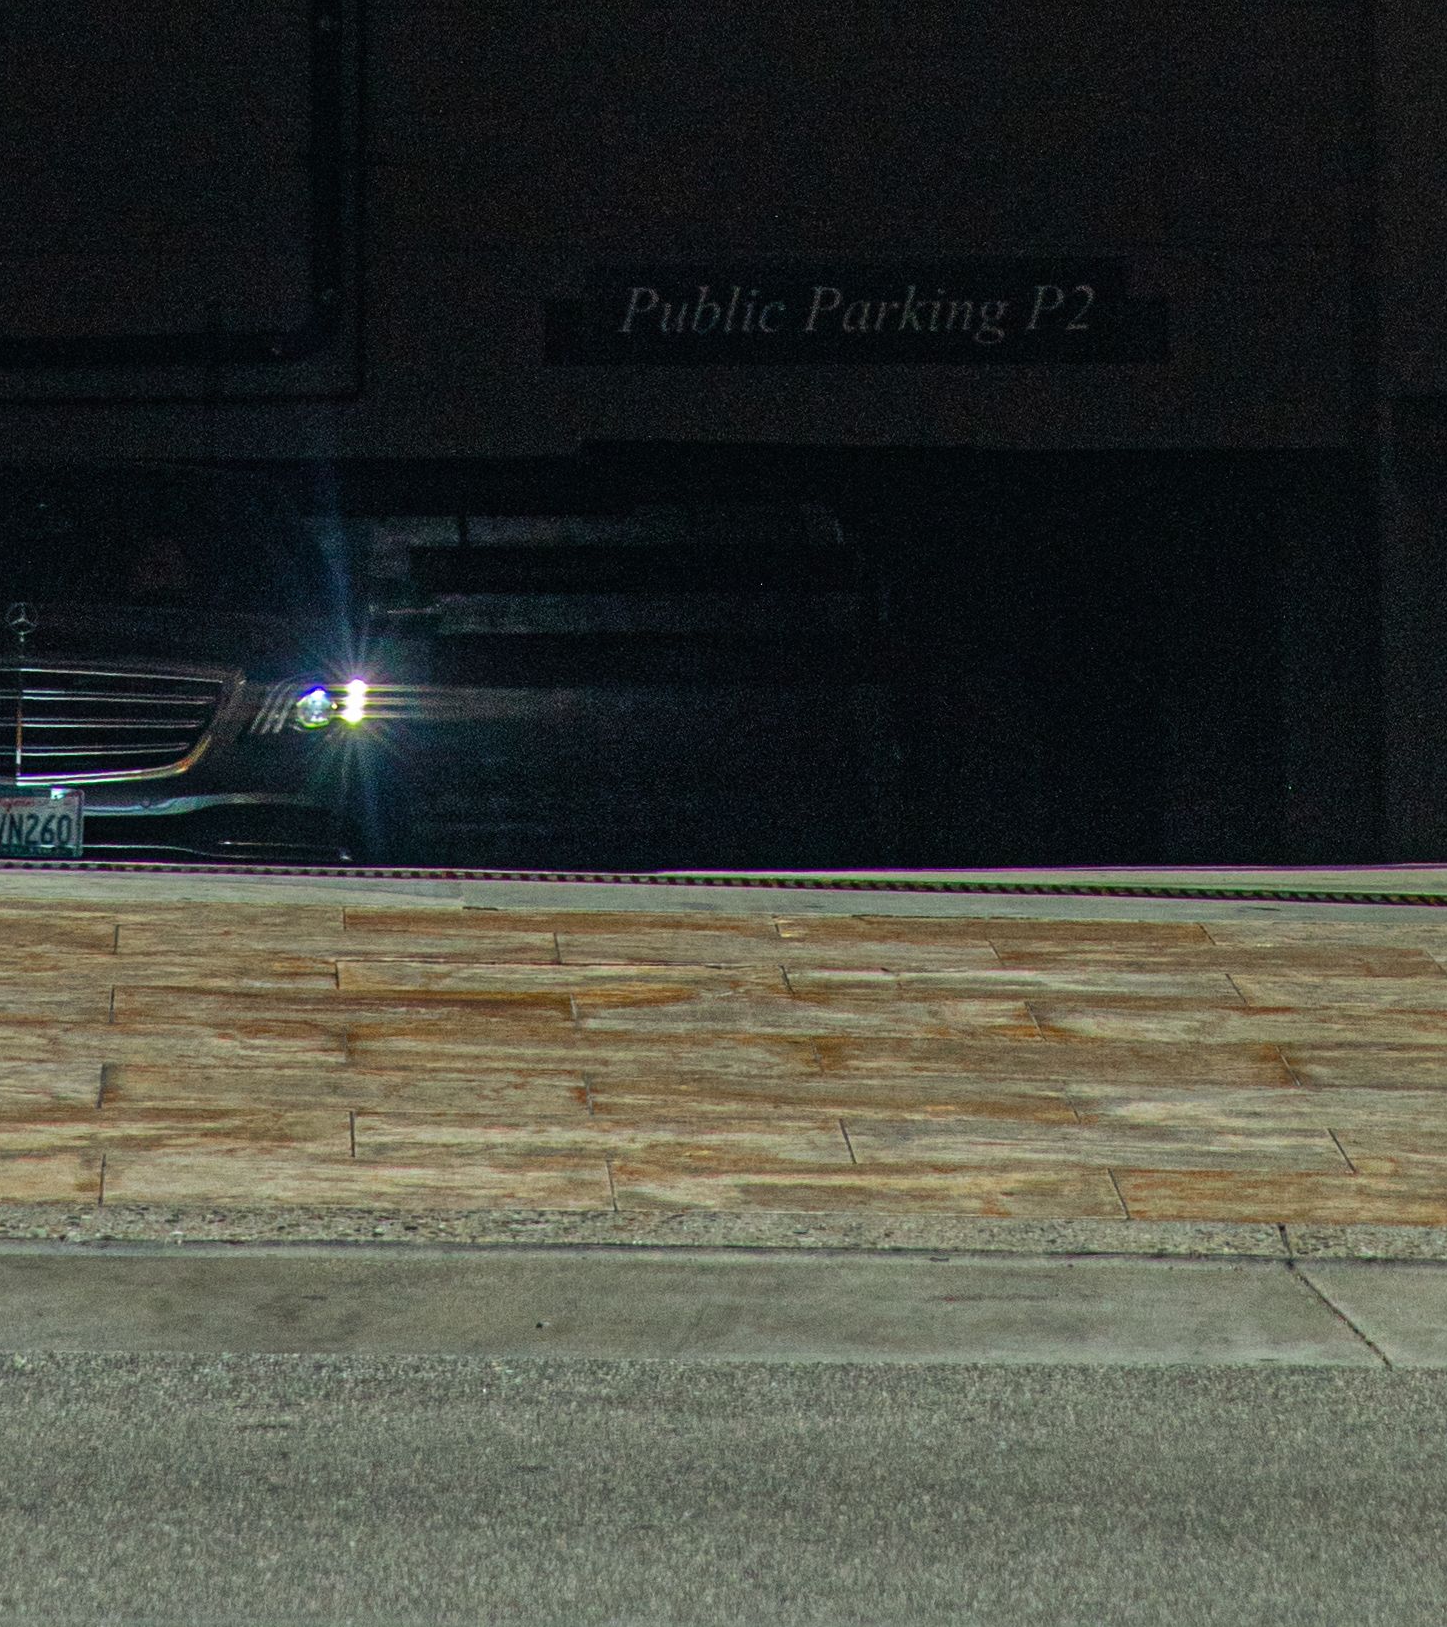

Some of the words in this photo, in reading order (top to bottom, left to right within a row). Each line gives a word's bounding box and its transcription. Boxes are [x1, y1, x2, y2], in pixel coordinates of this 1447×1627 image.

[617, 285, 787, 334] Public
[804, 285, 1010, 345] Parking
[1024, 283, 1097, 332] P2
